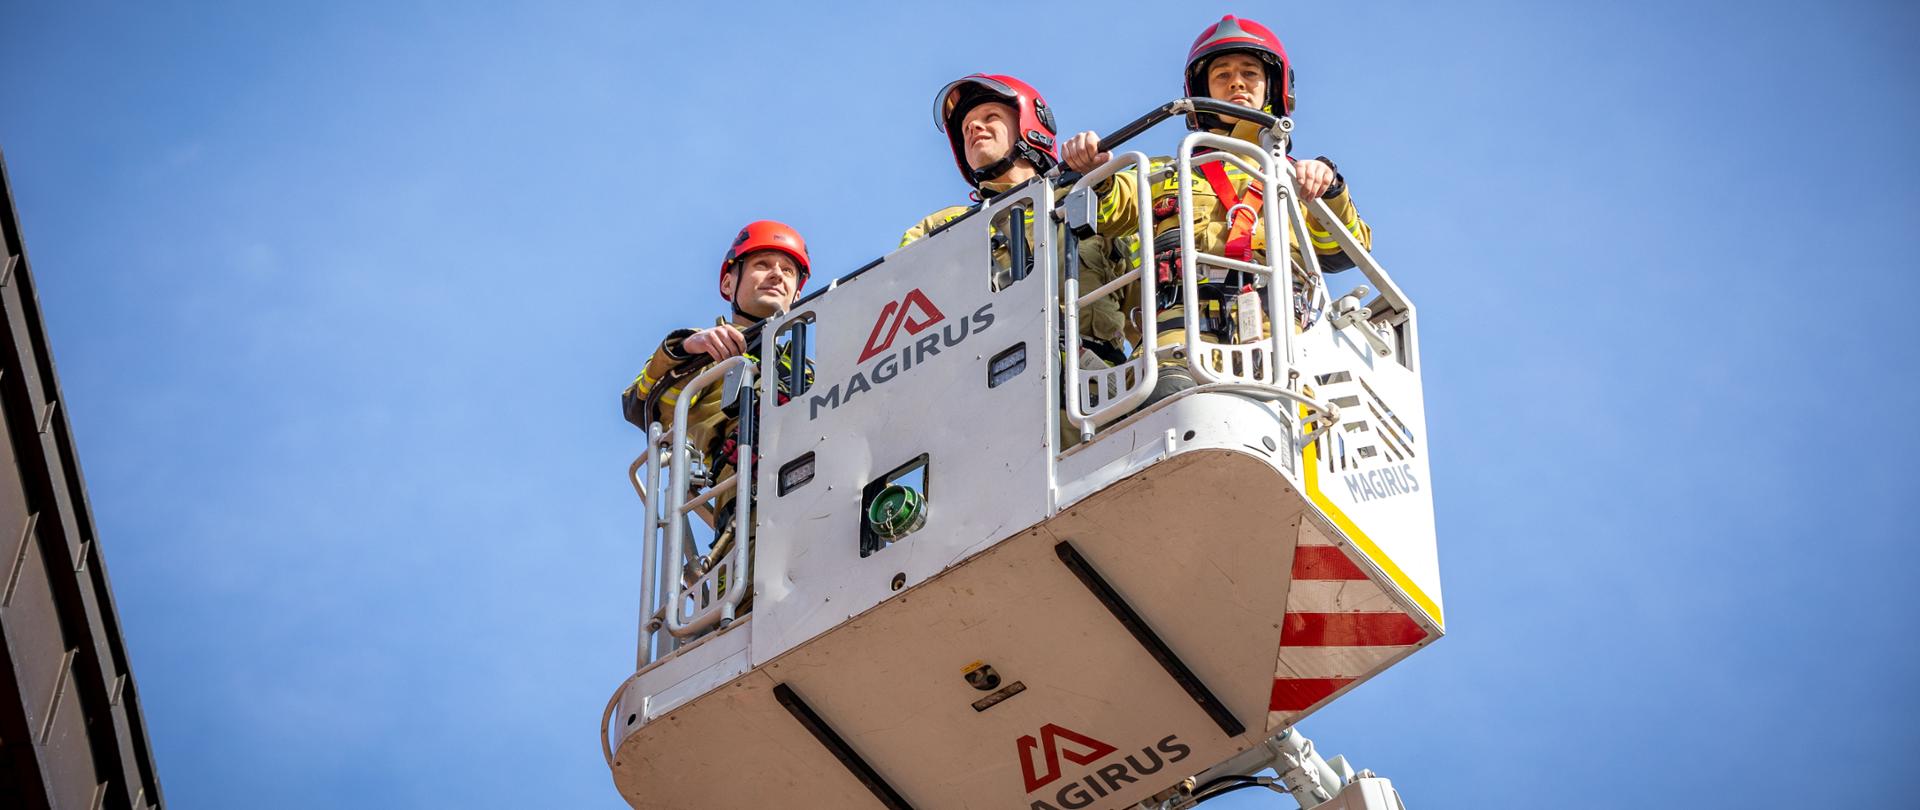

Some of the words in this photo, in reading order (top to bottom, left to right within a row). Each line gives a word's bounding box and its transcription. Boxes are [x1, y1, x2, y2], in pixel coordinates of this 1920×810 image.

[810, 303, 995, 421] MAGIRUS
[1344, 464, 1420, 504] MAGIRUS
[1030, 734, 1191, 810] GIRUS
